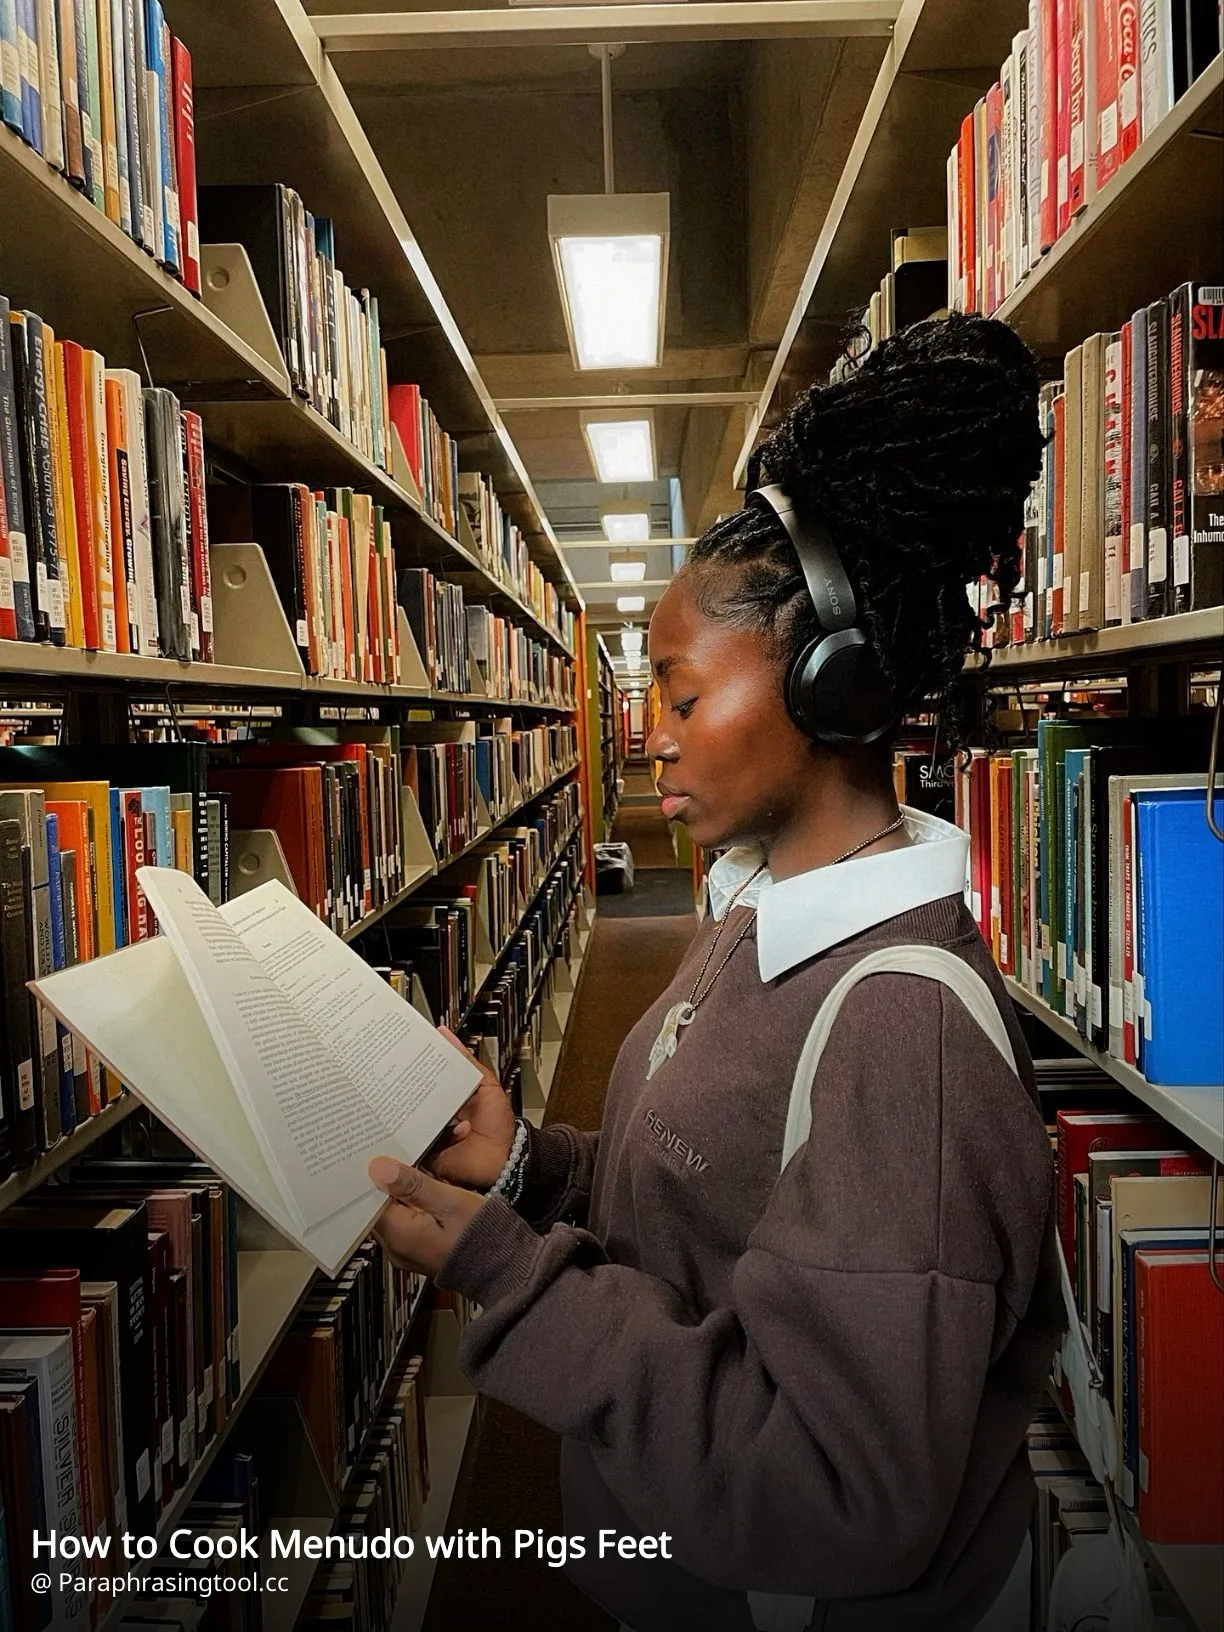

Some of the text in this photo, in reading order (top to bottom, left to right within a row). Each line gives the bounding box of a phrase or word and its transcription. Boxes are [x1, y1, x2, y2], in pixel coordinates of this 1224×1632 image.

[33, 336, 46, 401] Energy
[1148, 321, 1158, 424] SLAUGHTERHOUSE
[1171, 313, 1183, 416] SLAUGHTERHOUSE
[39, 403, 51, 449] Crisis
[5, 416, 17, 476] Governance
[12, 492, 22, 527] Energy
[100, 432, 109, 493] Energizing
[1173, 479, 1183, 508] GAIL
[121, 458, 130, 494] Saving
[126, 538, 136, 584] Growin
[1150, 483, 1159, 508] GAIL
[1208, 513, 1224, 527] The
[48, 523, 60, 580] 1975-77
[103, 494, 111, 574] Neoliberalism
[824, 578, 841, 616] SONY
[919, 764, 954, 780] SMO
[644, 1109, 711, 1173] RENEW
[54, 1411, 75, 1509] SILVER
